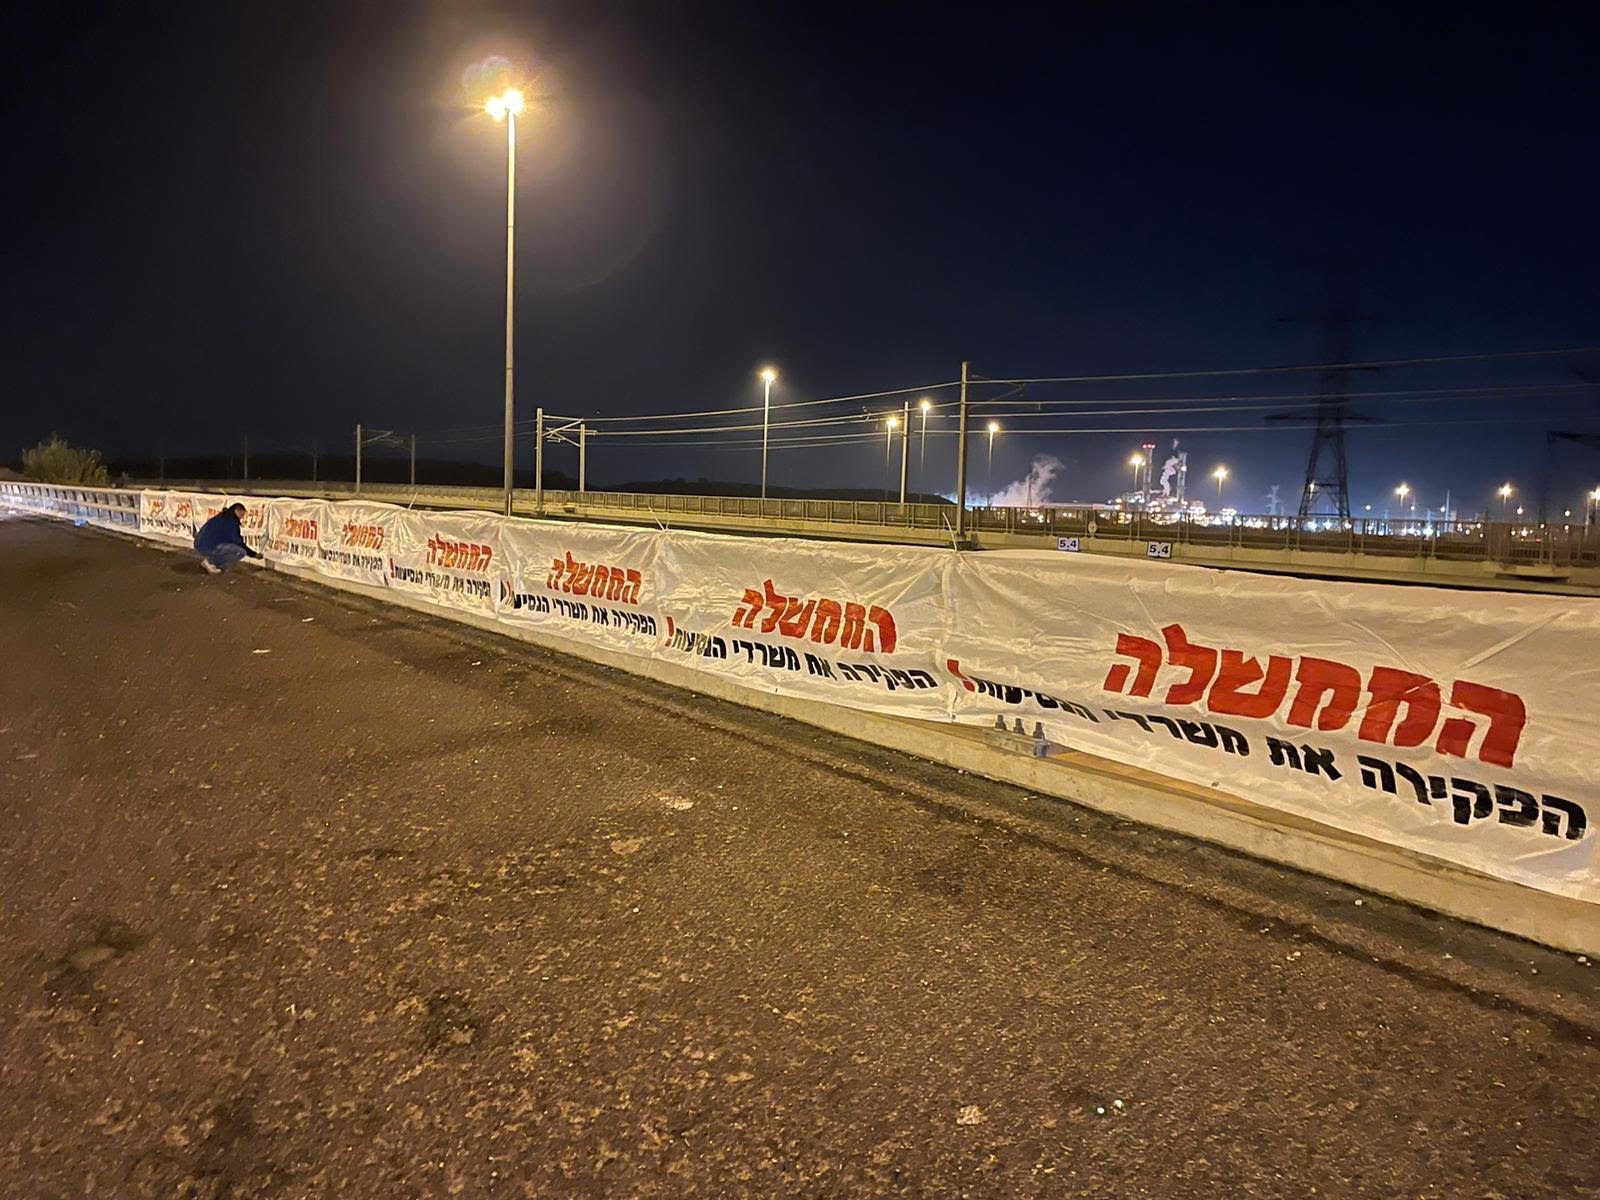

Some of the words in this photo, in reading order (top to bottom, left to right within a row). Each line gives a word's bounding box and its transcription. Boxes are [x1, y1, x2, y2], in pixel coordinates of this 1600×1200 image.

[1060, 540, 1077, 548] 5.4
[1149, 544, 1169, 554] 5.4
[546, 551, 642, 604] הממשלה
[552, 599, 589, 621] משרדי
[591, 605, 610, 626] את
[611, 609, 657, 636] הפקירה
[732, 579, 897, 654] הממשלה
[732, 639, 800, 671] משרדי
[804, 652, 837, 681] את
[836, 662, 938, 691] הפקירה
[1103, 623, 1528, 769] הממשלה
[1102, 708, 1250, 757] משרדי
[1266, 736, 1343, 781] את
[1357, 755, 1588, 841] הפקירה
